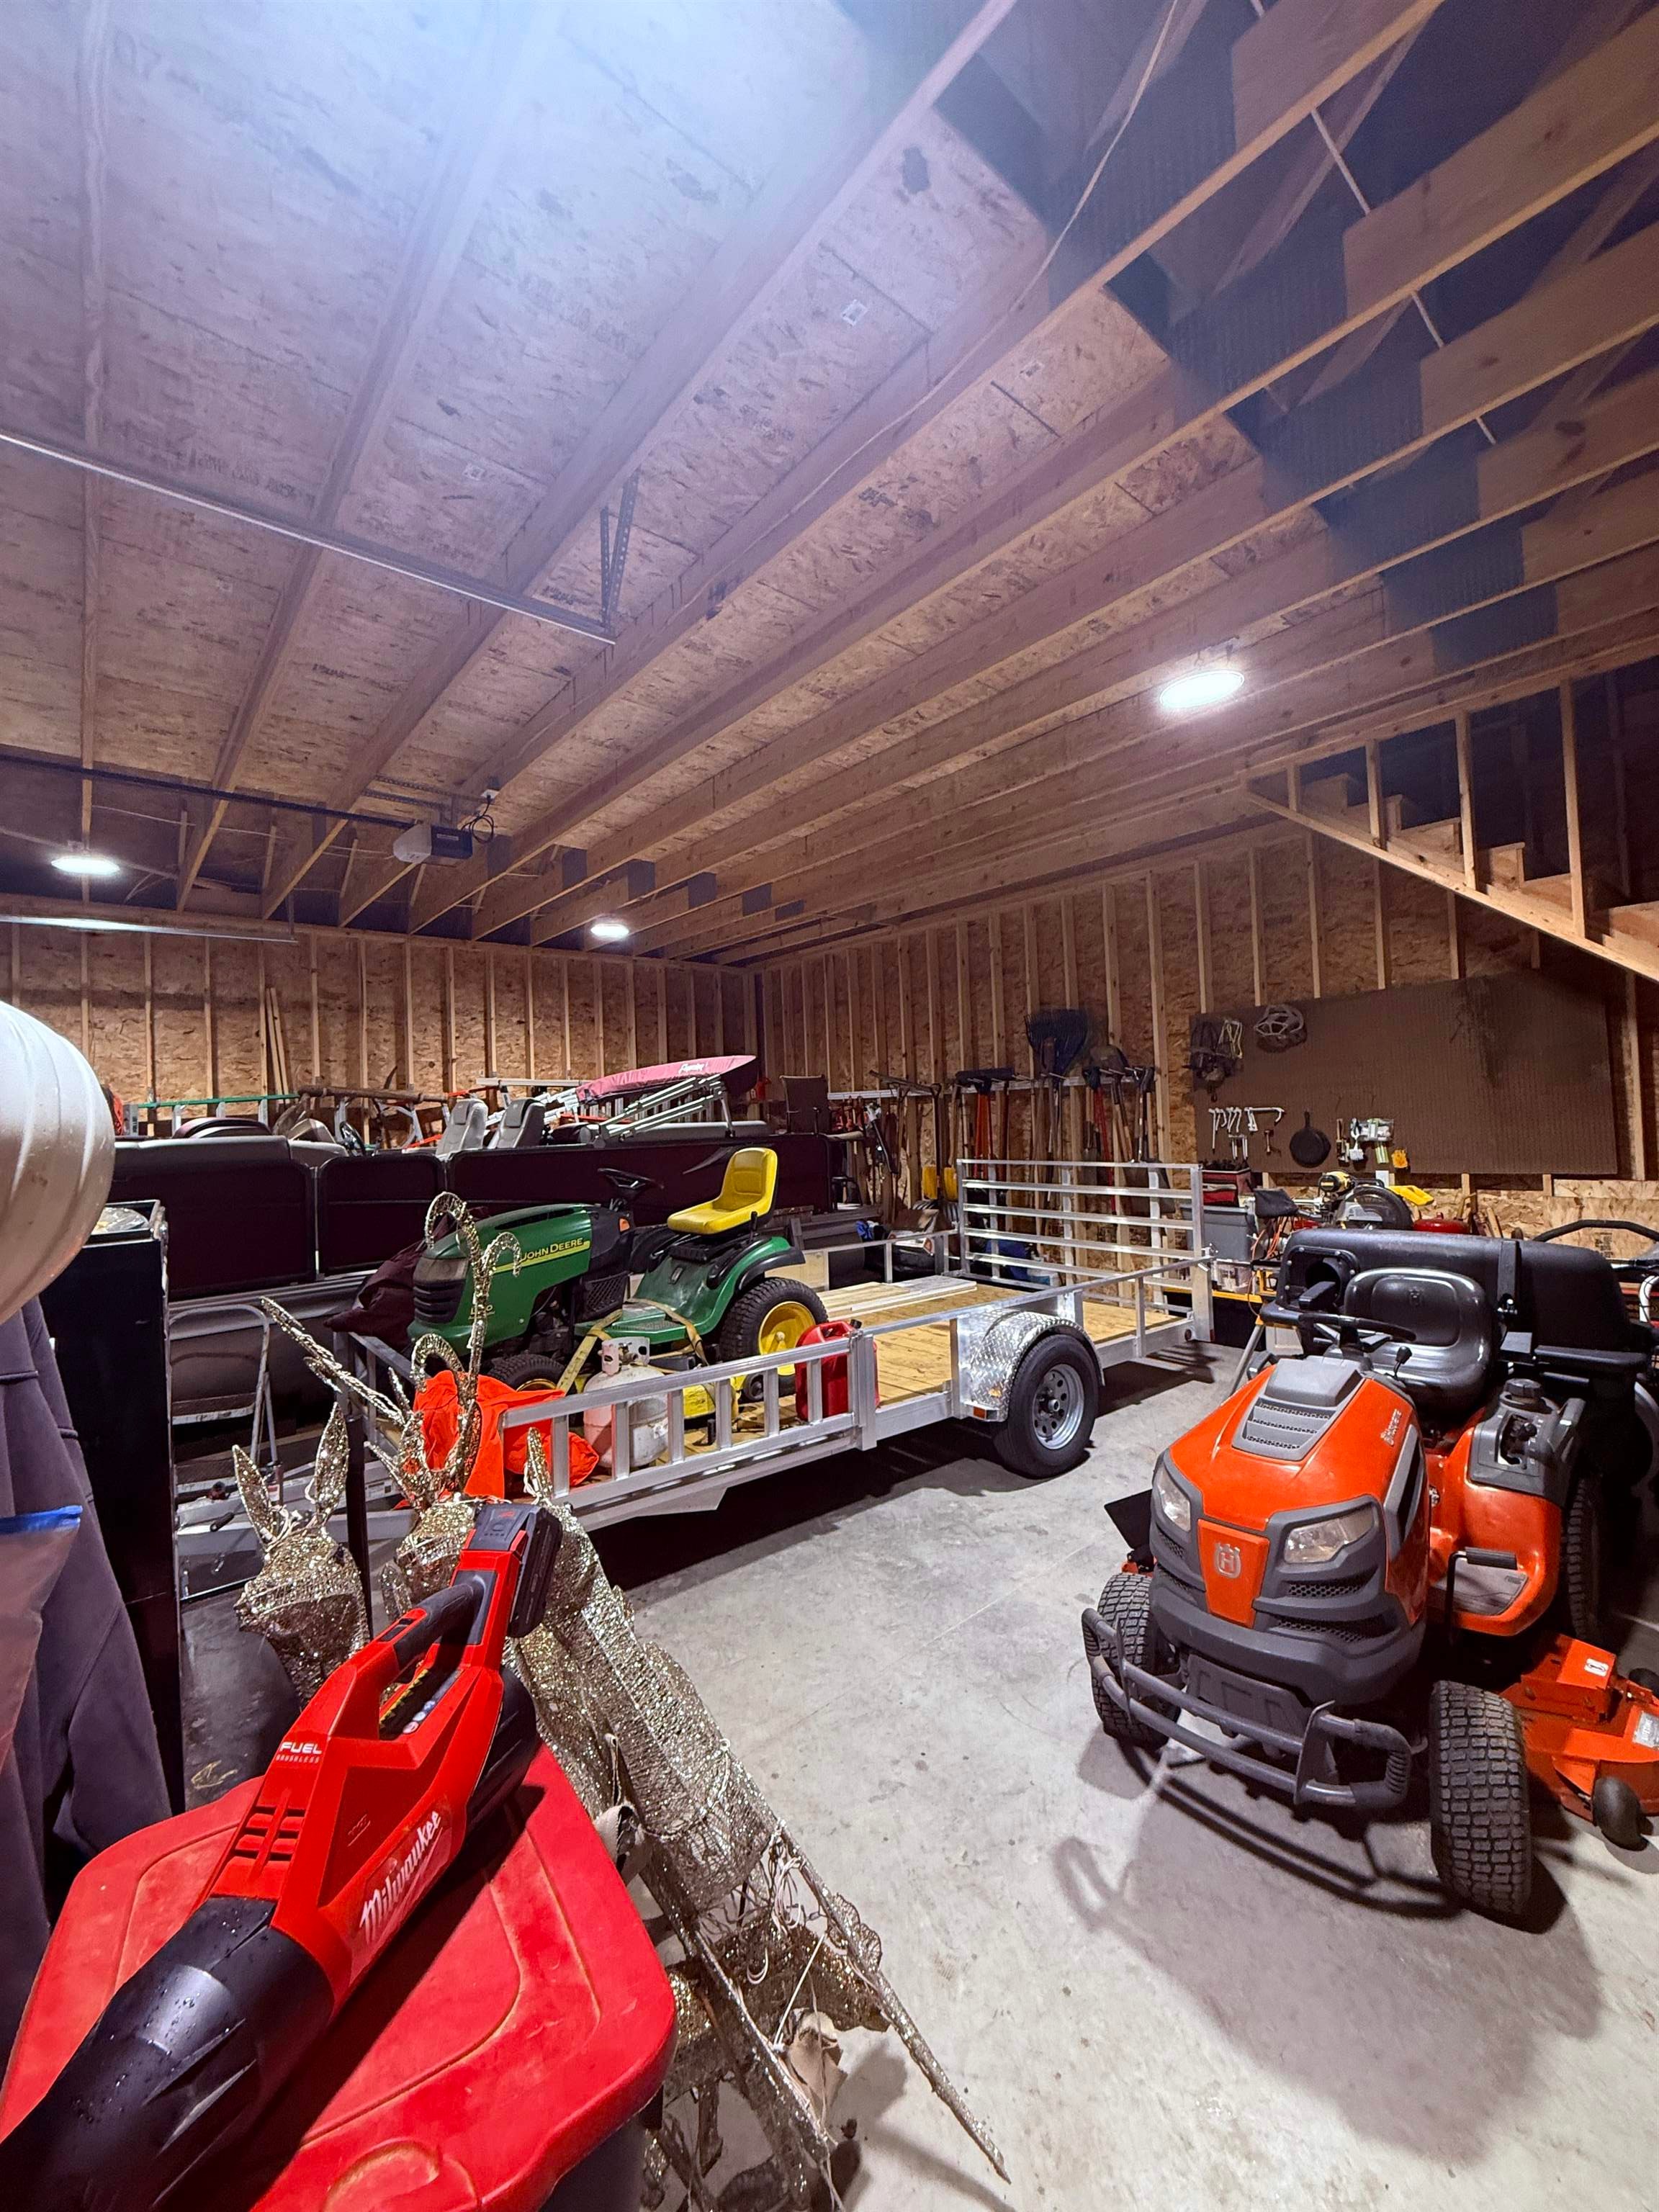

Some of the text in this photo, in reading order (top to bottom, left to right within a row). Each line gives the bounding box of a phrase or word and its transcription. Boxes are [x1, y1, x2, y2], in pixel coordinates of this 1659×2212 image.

[519, 1237, 584, 1264] JOHN DEERE
[279, 1740, 323, 1755] FUEL
[359, 1810, 441, 1945] Milwaukee
